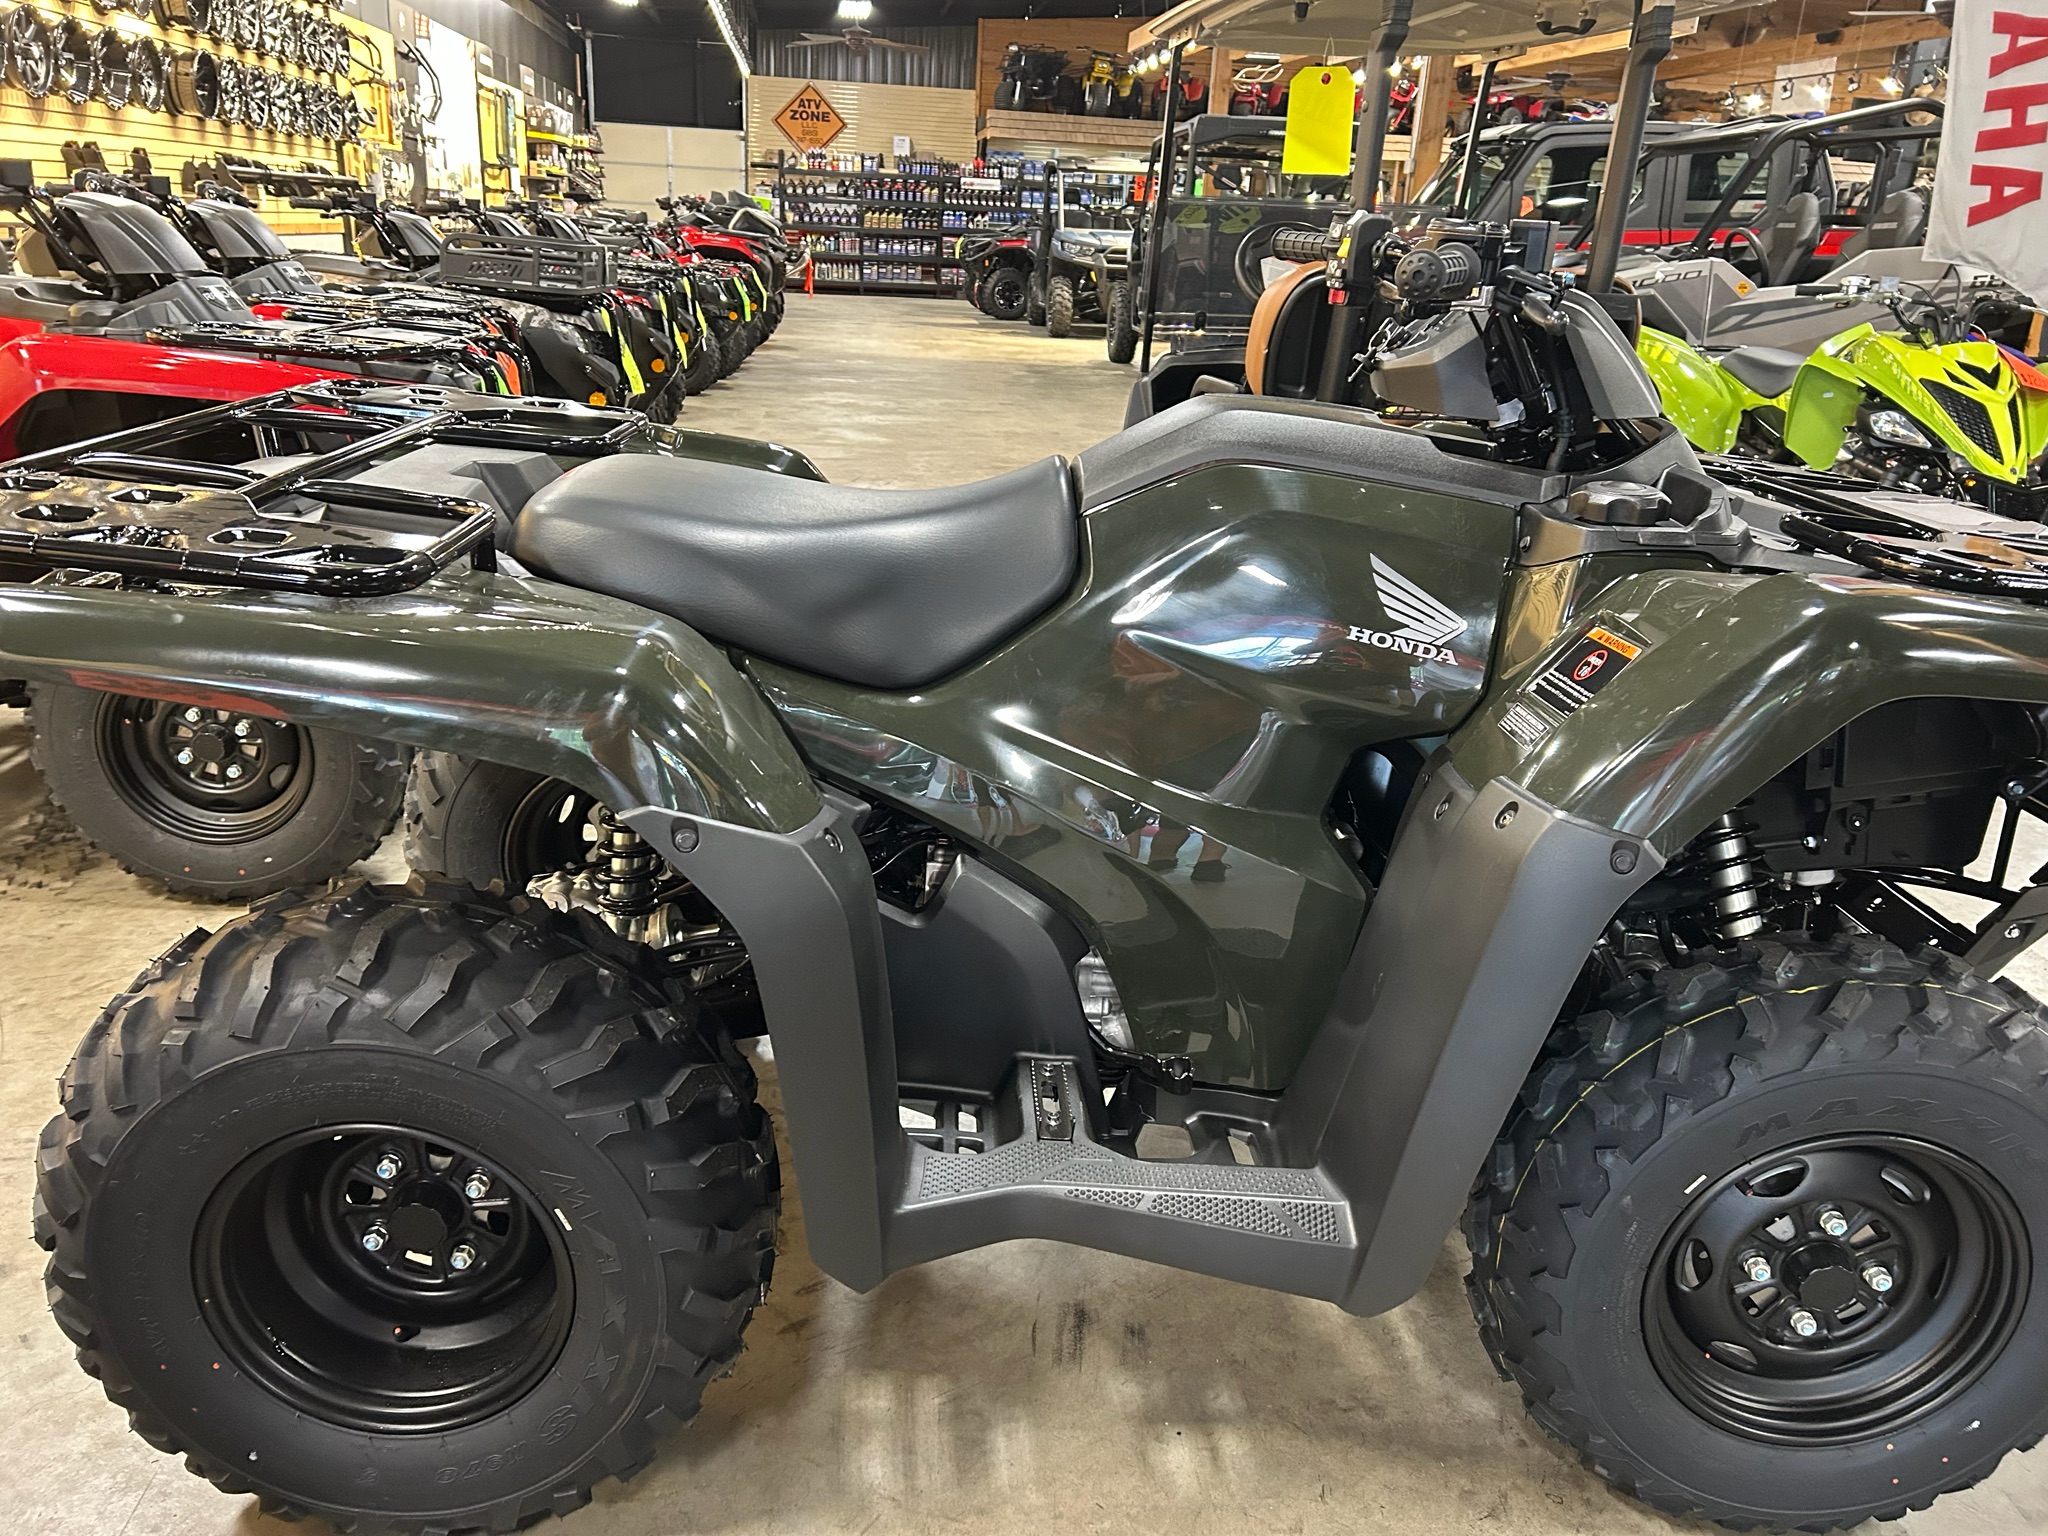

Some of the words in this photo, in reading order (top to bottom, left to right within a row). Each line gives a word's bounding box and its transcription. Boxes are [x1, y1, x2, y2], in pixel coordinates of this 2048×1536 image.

[797, 98, 822, 110] ATV
[789, 109, 832, 122] ZONE
[1346, 625, 1459, 666] HONDA
[1603, 635, 1631, 654] WARNING
[1578, 665, 1591, 677] 16
